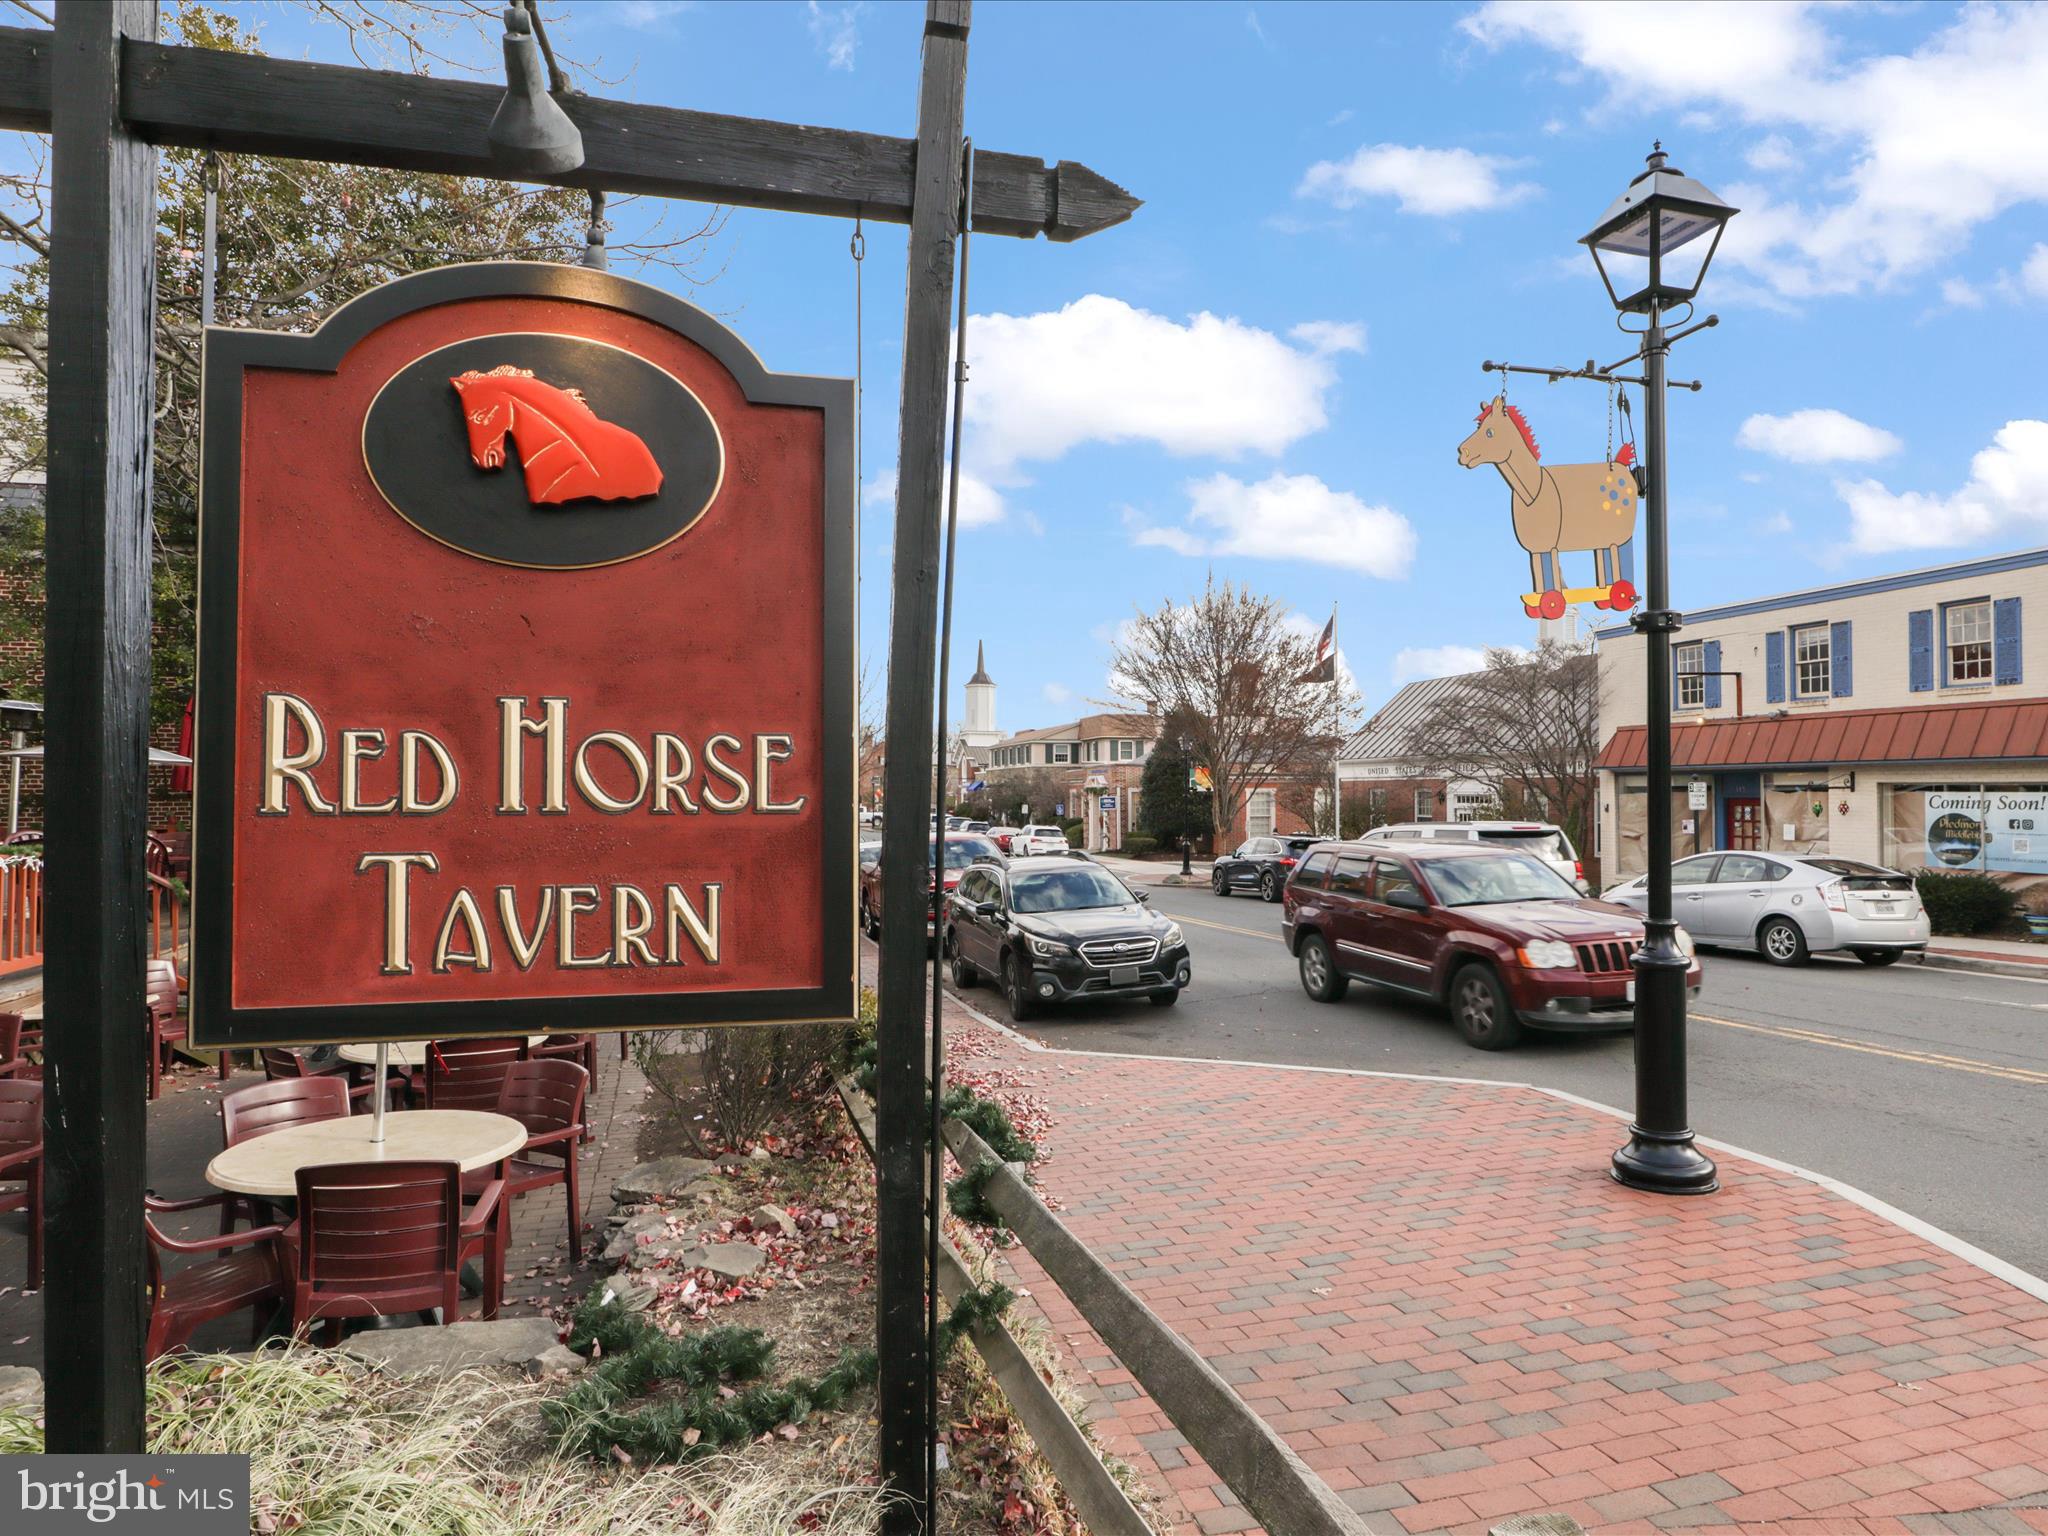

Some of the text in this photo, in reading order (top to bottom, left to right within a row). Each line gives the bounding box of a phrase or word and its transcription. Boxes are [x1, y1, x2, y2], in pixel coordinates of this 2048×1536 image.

[259, 691, 806, 815] RED HORSE
[1367, 767, 1389, 775] UNITED
[1929, 795, 2046, 814] Coming Soon!
[1939, 817, 1985, 829] Piedmon
[356, 851, 723, 973] TAVERN
